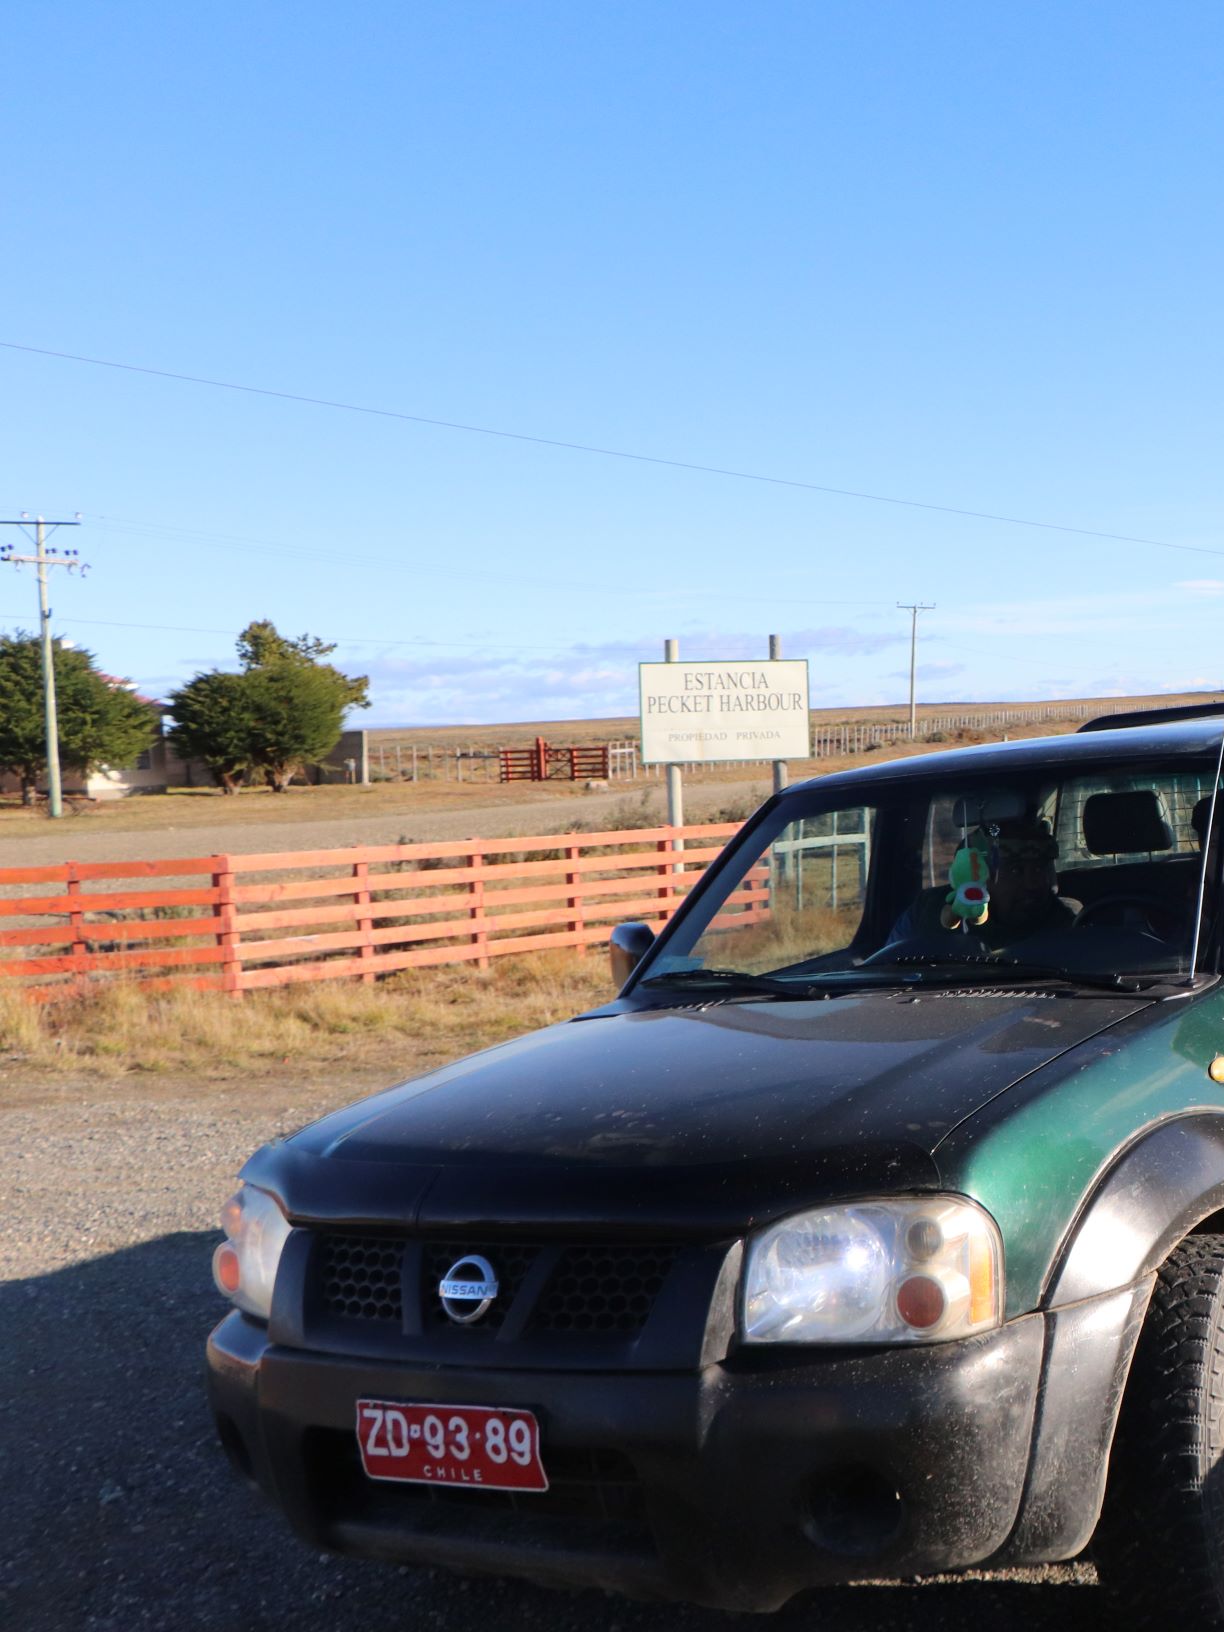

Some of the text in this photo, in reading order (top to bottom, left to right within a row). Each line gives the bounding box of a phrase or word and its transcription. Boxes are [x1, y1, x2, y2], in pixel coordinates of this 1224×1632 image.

[684, 671, 769, 691] ESTANCIA
[647, 692, 803, 714] PECKET HARBOUR
[668, 730, 781, 742] PROPIEDAD PRIVADA
[441, 1284, 488, 1296] NISSAN
[423, 1465, 483, 1481] CHILE
